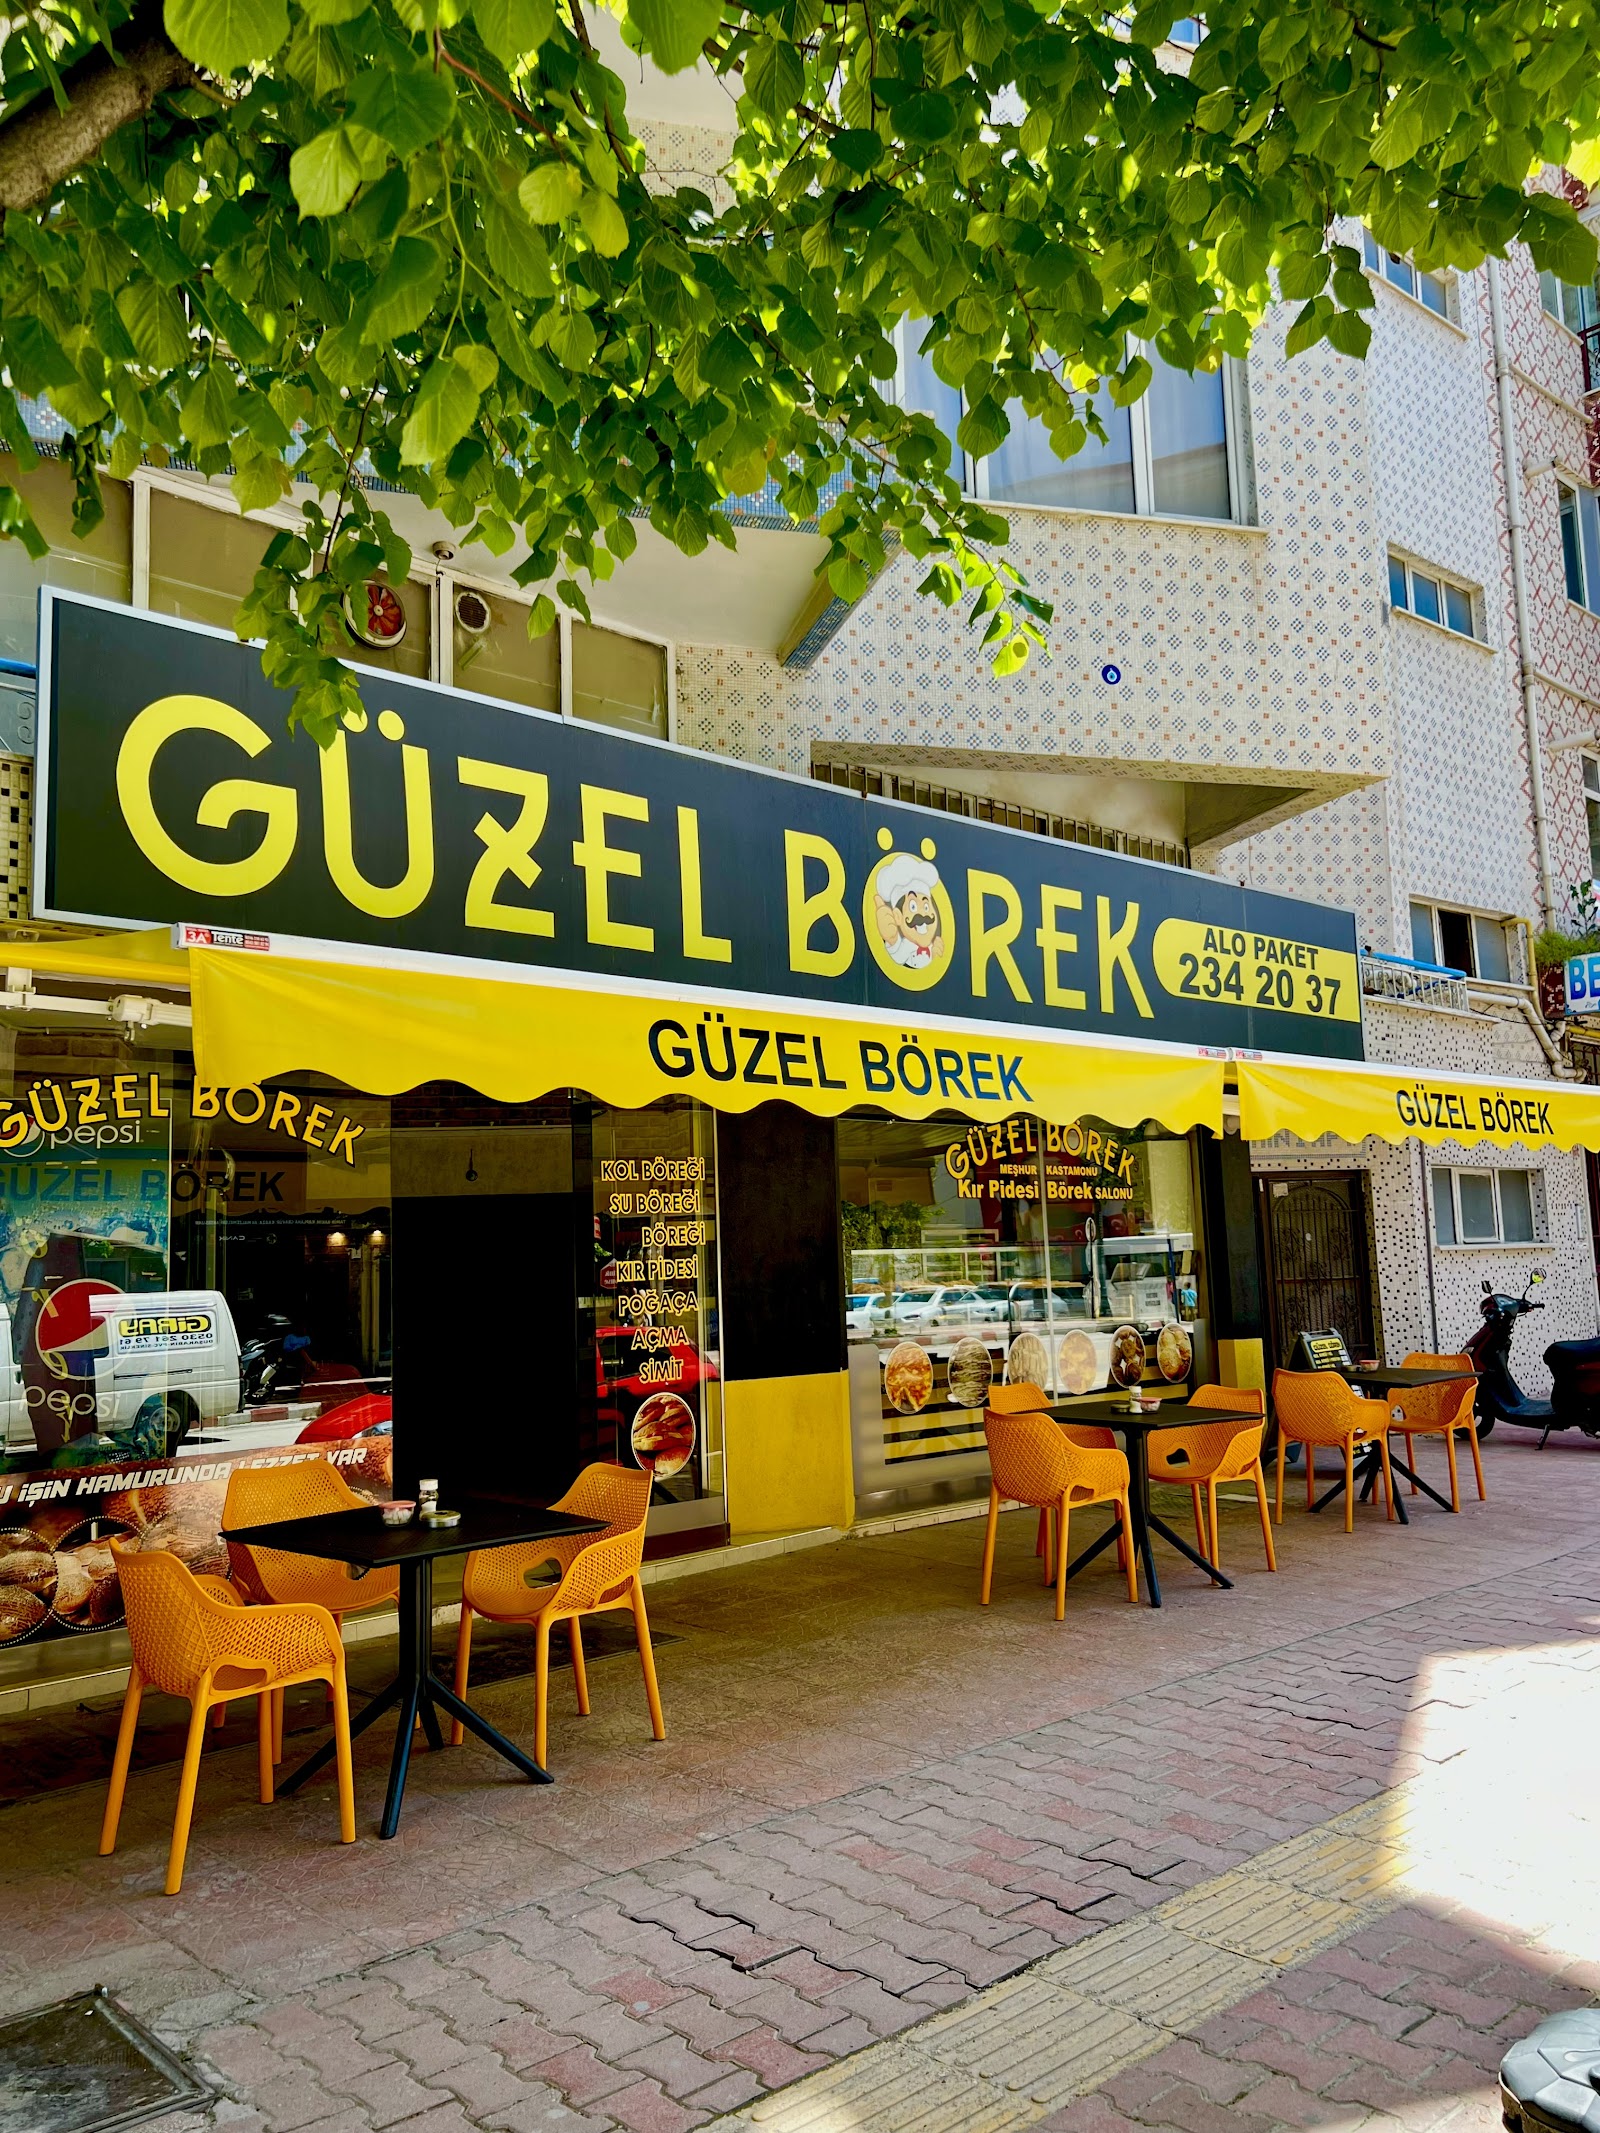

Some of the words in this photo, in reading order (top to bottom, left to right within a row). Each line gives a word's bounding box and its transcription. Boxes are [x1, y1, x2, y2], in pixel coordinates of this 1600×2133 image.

[116, 695, 732, 963] GÜZEL
[784, 827, 1154, 1018] BÖREK
[1203, 928, 1246, 957] ALO
[1254, 936, 1319, 970] PAKET
[1179, 953, 1244, 1001] 234
[1255, 965, 1294, 1008] 20
[1306, 974, 1341, 1015] 37
[648, 1012, 847, 1090] GÜZEL
[859, 1034, 1034, 1102] BÖREK
[1396, 1084, 1476, 1131] GÜZEL
[1479, 1092, 1555, 1135] BÖREK
[50, 1120, 141, 1150] pepsi
[945, 1119, 1037, 1180] GÜZEL
[1046, 1120, 1135, 1187] BÖREK
[600, 1160, 639, 1181] KOL
[642, 1156, 705, 1181] BÖREĞİ
[1000, 1164, 1037, 1177] MEŞHUR
[1046, 1165, 1098, 1176] KASTAMONU
[609, 1193, 632, 1214] SU
[636, 1188, 700, 1214] BÖREĞİ
[958, 1179, 984, 1198] Kır
[989, 1179, 1039, 1199] Pidesi
[1047, 1180, 1093, 1199] Börek
[1095, 1187, 1133, 1200] SALONU
[641, 1221, 706, 1247] BÖREĞİ
[616, 1260, 645, 1282] KIR
[648, 1254, 698, 1280] PİDESİ
[618, 1289, 699, 1318] POĞAÇA
[631, 1325, 690, 1353] AÇMA
[639, 1356, 683, 1384] SİMİT
[19, 1385, 120, 1421] pepsi
[76, 1462, 232, 1496] HAMURUNDA
[327, 1448, 367, 1466] VAR
